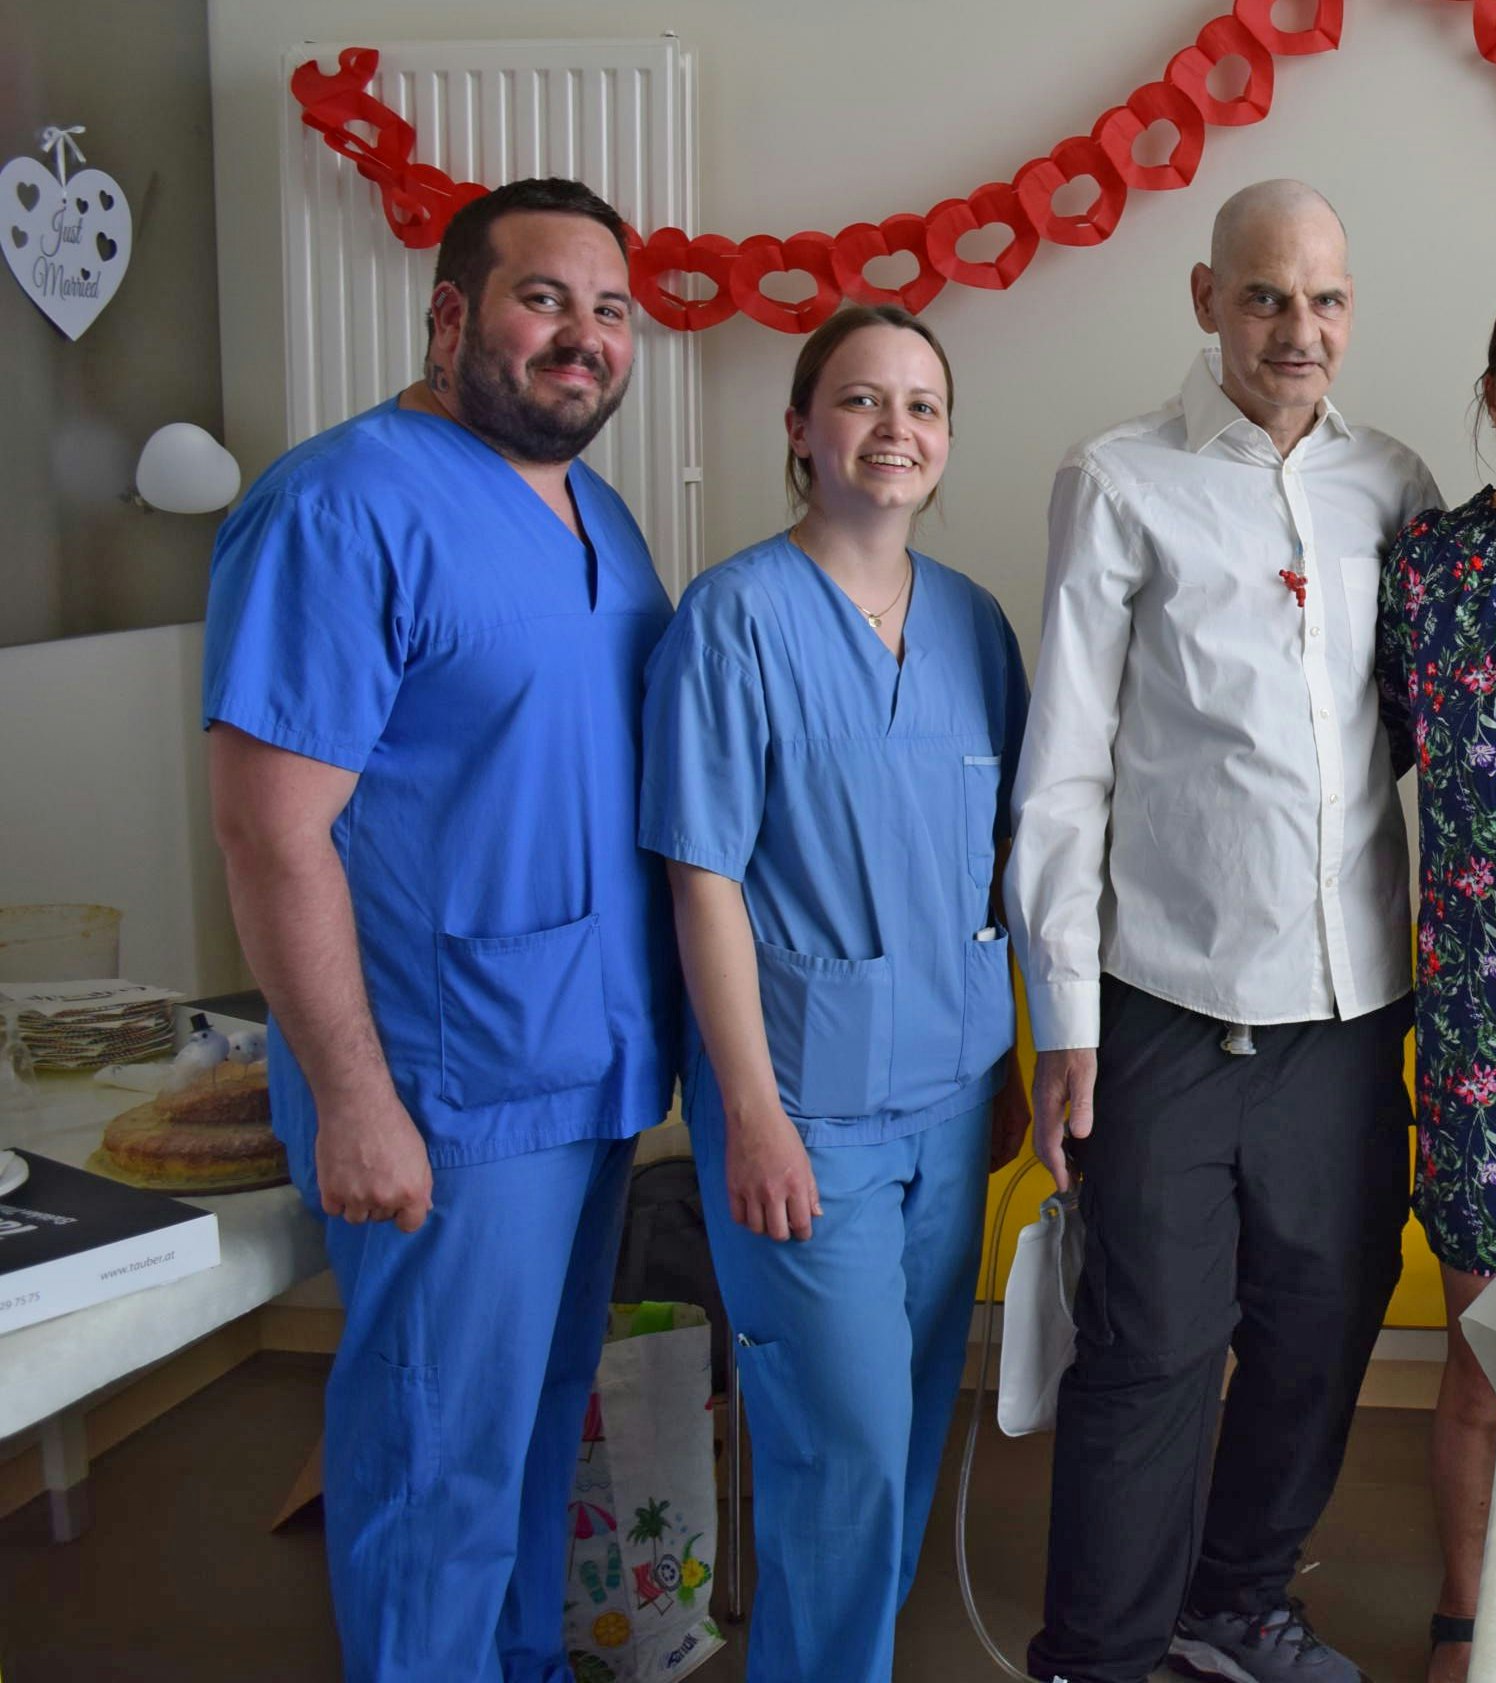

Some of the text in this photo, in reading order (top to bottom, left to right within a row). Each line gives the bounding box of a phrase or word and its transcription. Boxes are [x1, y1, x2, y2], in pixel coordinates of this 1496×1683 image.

[40, 205, 83, 257] Just
[32, 256, 101, 300] Married
[100, 1250, 175, 1280] www.tauber.at
